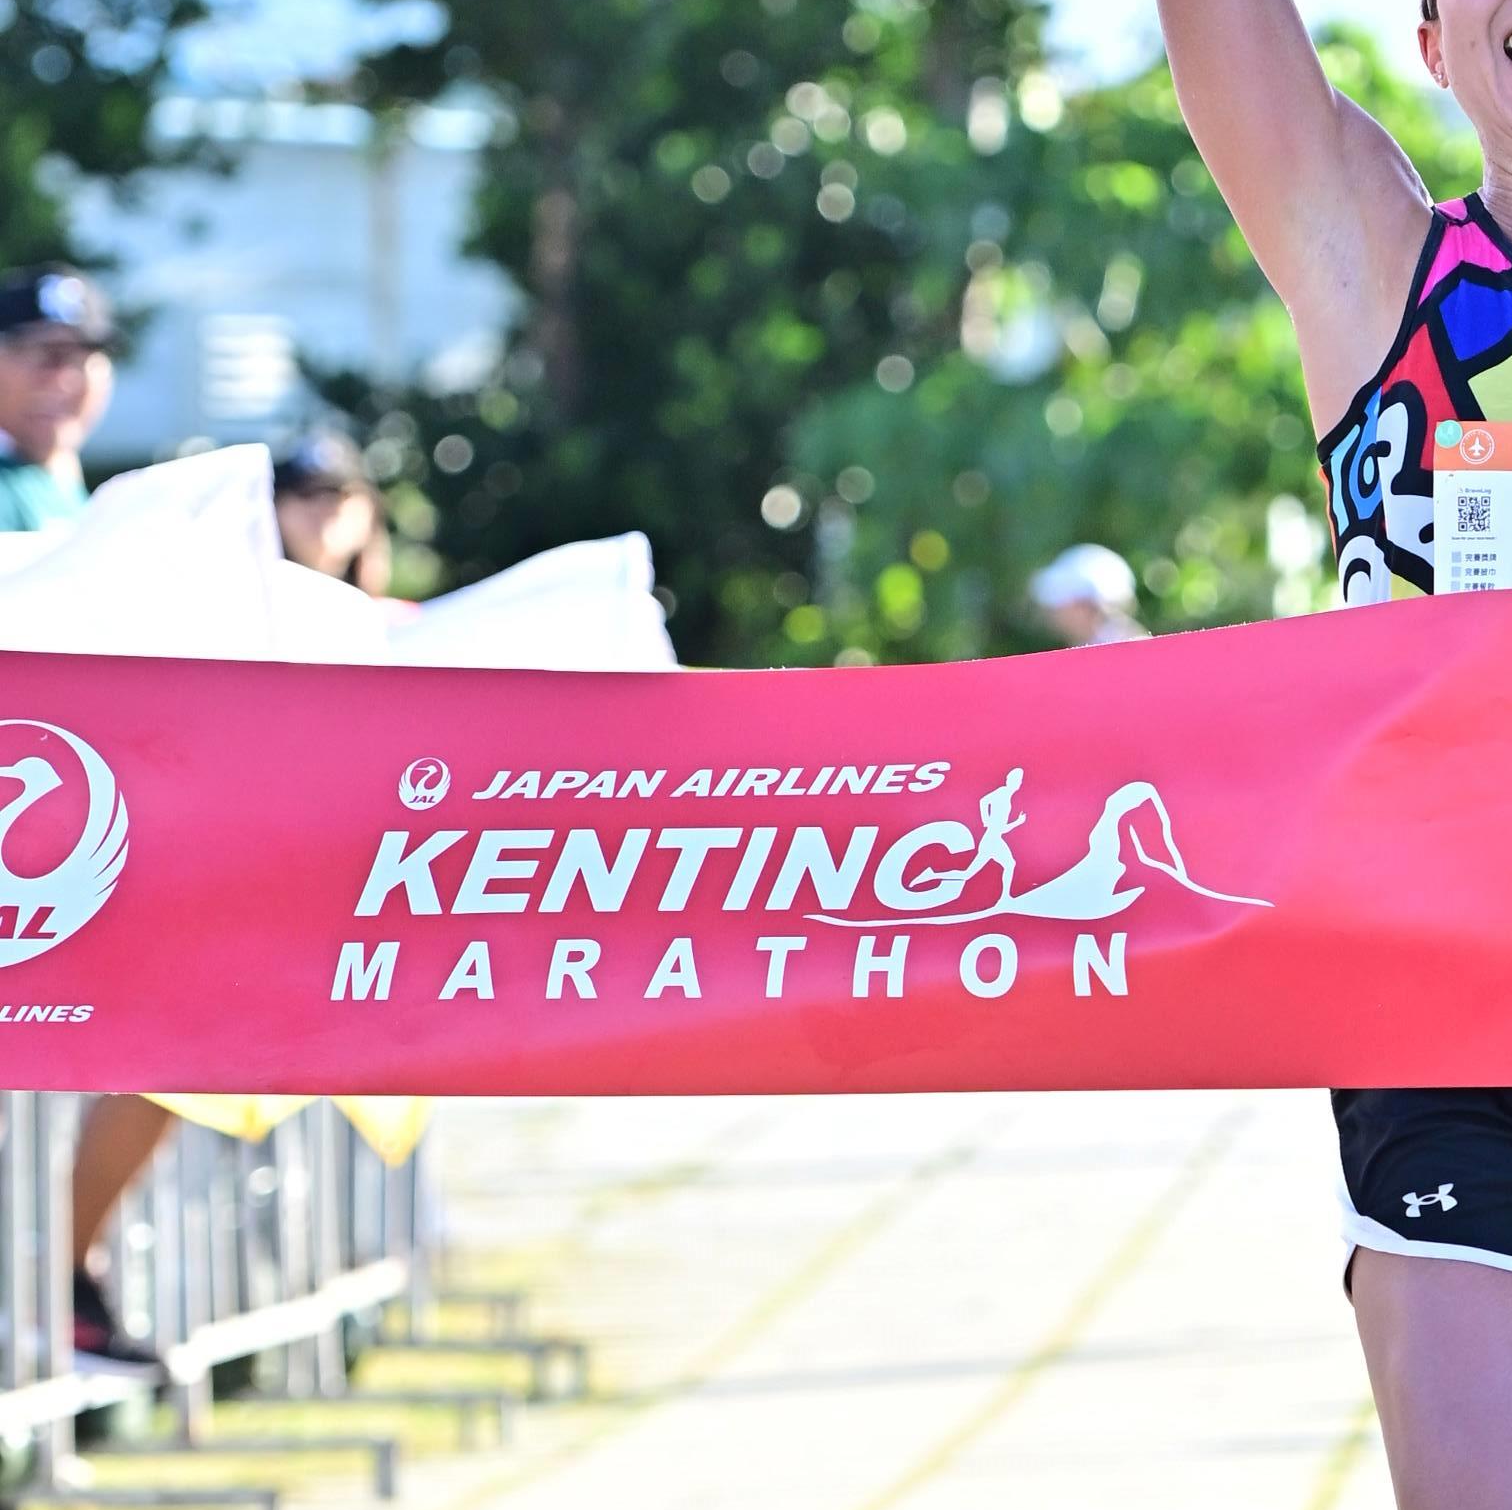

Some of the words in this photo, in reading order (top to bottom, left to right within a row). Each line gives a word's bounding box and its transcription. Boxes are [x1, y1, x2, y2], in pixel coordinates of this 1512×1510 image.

[408, 795, 437, 804] JAL
[472, 769, 667, 800] JAPAN
[670, 762, 951, 798] AIRLINES
[353, 820, 977, 917] KENTING
[330, 933, 1129, 1001] MARATHON
